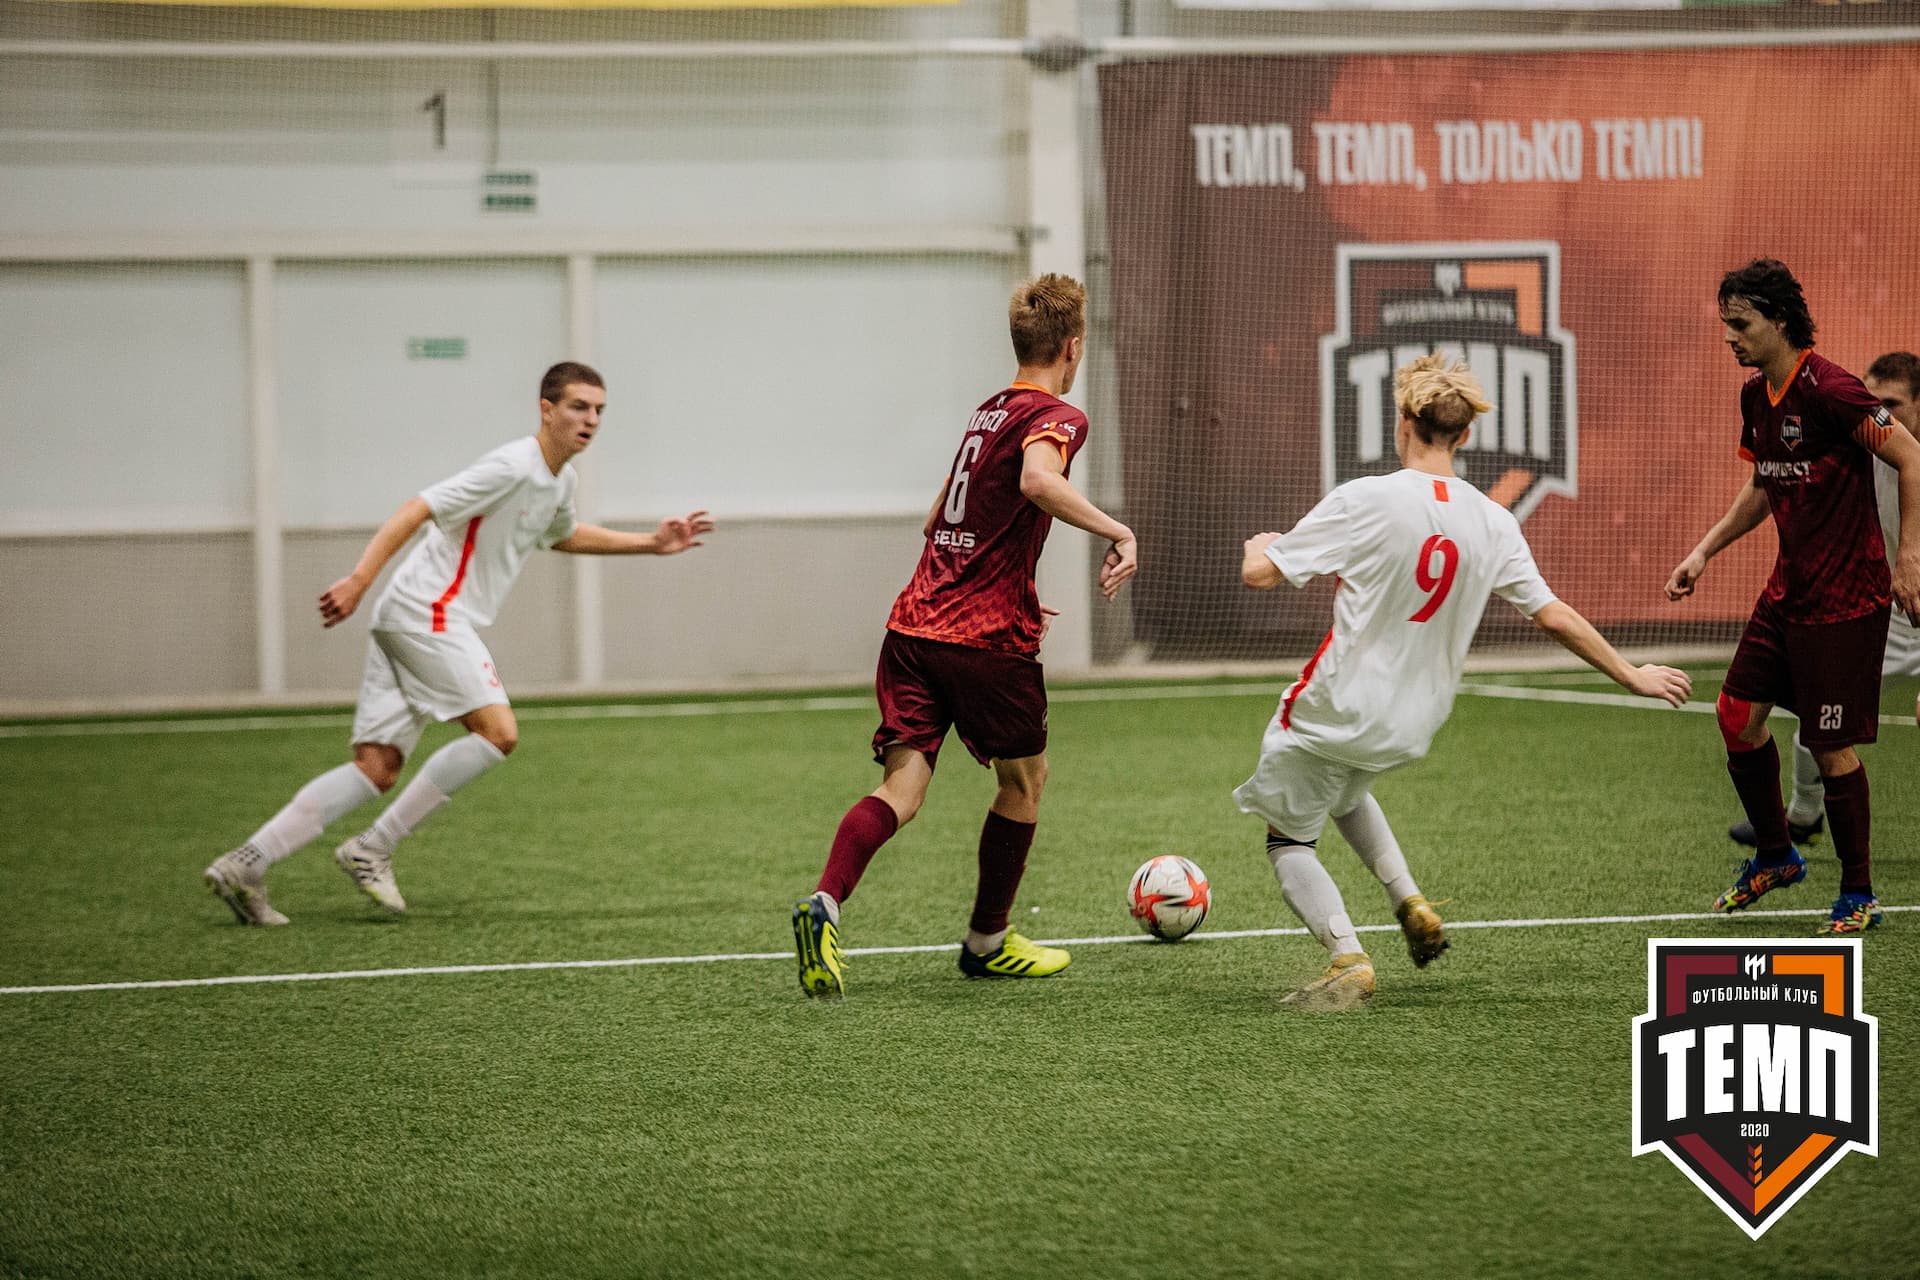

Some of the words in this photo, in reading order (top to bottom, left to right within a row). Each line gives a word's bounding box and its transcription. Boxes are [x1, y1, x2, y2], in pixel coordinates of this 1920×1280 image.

[419, 94, 446, 150] 1
[1192, 123, 1306, 192] ТЕМП,
[1313, 121, 1427, 191] ТЕМП,
[1435, 119, 1582, 184] ТОЛЬКО
[1592, 117, 1703, 181] ТЕМП!
[944, 434, 984, 524] 6
[1406, 534, 1459, 623] 9
[1819, 704, 1843, 730] 23
